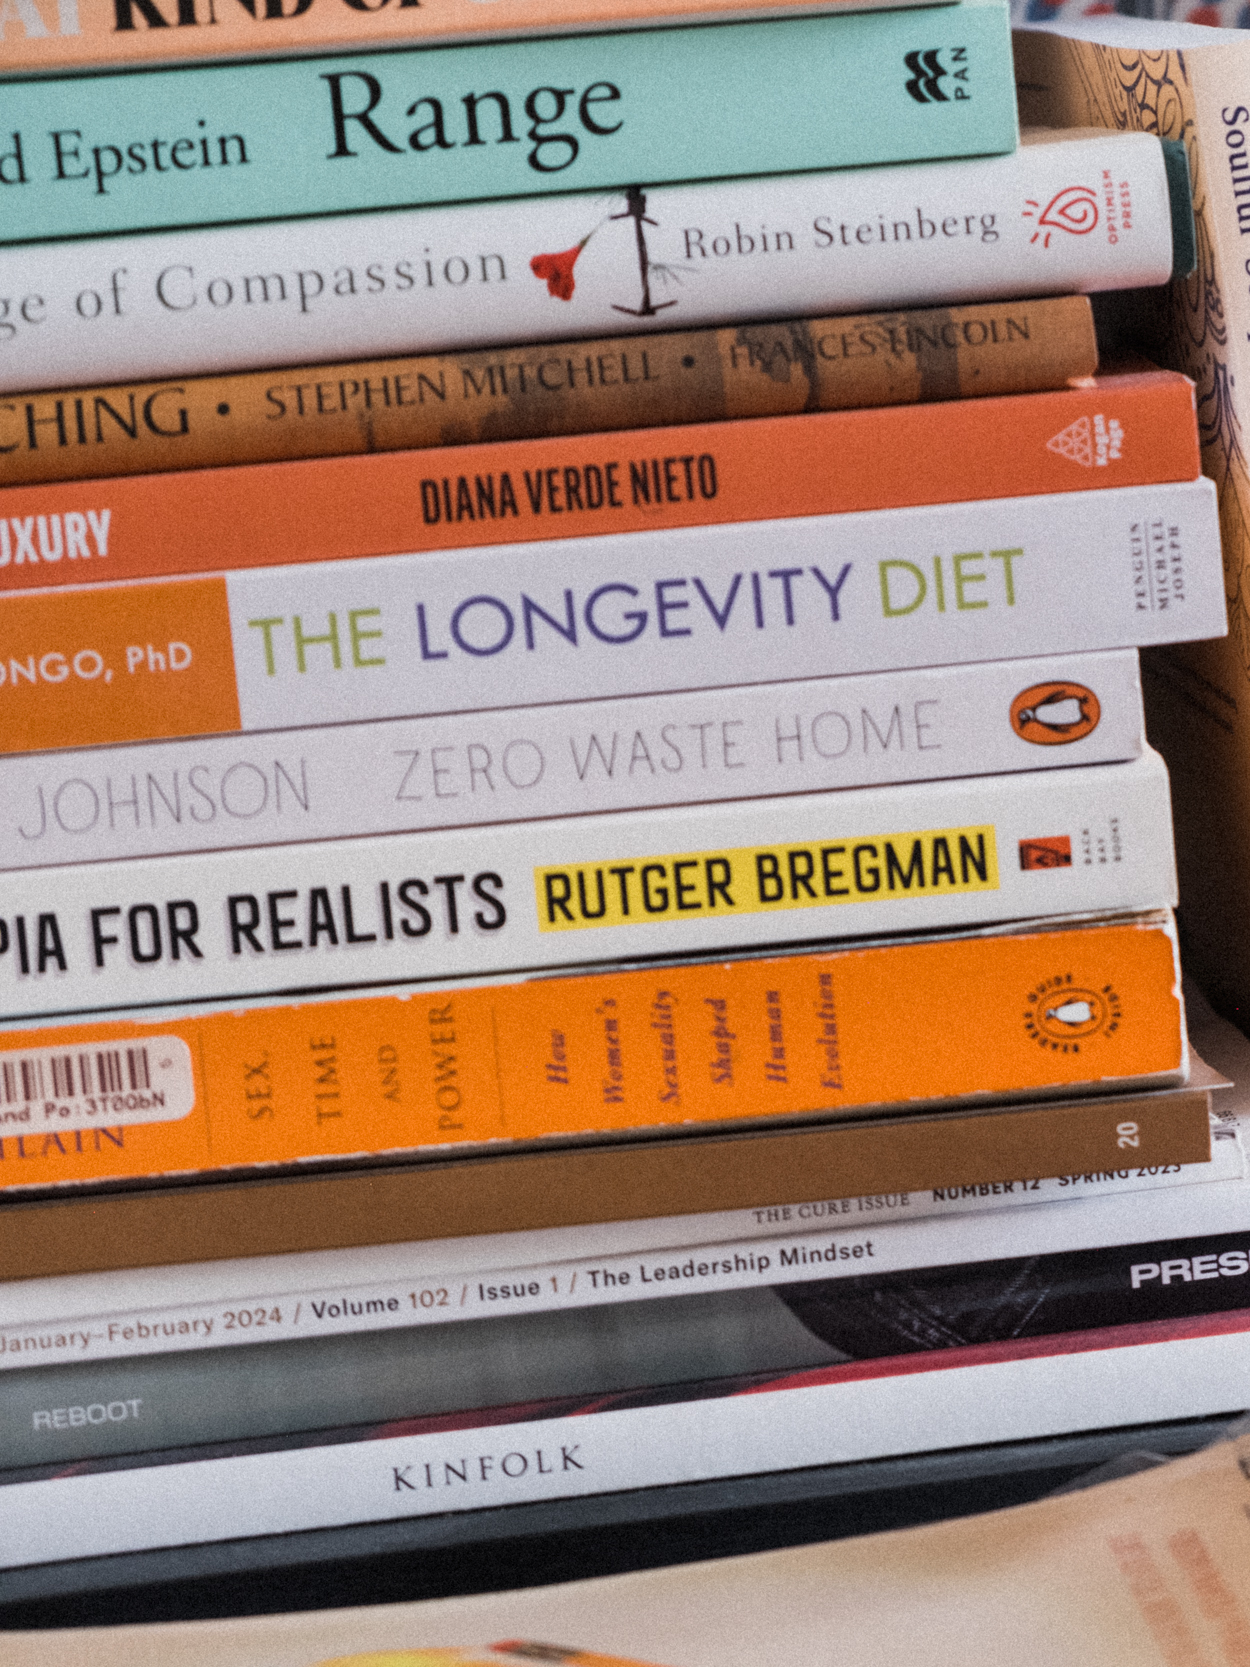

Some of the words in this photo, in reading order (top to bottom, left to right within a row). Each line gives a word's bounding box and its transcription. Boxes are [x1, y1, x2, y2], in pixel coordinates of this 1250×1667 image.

[953, 46, 968, 101] PAN
[48, 119, 250, 196] Epstein
[319, 70, 625, 173] Range
[682, 220, 796, 260] Robin
[813, 207, 1000, 248] Steinberg
[1102, 168, 1119, 245] OPTIMISM
[1120, 180, 1133, 230] PRESS
[75, 268, 128, 322] of
[155, 246, 508, 314] Compassion
[264, 369, 448, 421] STEPHEN
[462, 350, 660, 400] MITCHELL
[419, 470, 519, 525] DIANA
[523, 461, 622, 514] VERDE
[629, 453, 718, 506] NIETO
[1130, 521, 1147, 612] PENGUIN
[1153, 517, 1170, 612] MICHAEL
[1167, 524, 1185, 601] JOSEPH
[125, 641, 193, 674] PhD
[249, 607, 386, 676] THE
[416, 561, 853, 661] LONGEVITY
[877, 546, 1024, 619] DIET
[18, 757, 310, 841] JOHNSON
[394, 737, 545, 802] ZERO
[570, 720, 746, 781] WASTE
[775, 699, 943, 765] HOME
[89, 898, 205, 968] FOR
[228, 871, 508, 955] REALISTS
[544, 857, 735, 922] RUTGER
[755, 834, 989, 905] BREGMAN
[428, 1001, 464, 1131] POWER
[545, 1029, 569, 1085] How
[651, 989, 681, 1106] Sexuality
[704, 997, 737, 1087] Shaped
[765, 990, 789, 1084] Human
[812, 972, 844, 1091] Evolution
[309, 1035, 343, 1126] TIME
[377, 1044, 401, 1103] AND
[1116, 1120, 1140, 1149] 20
[752, 1206, 792, 1226] THE
[797, 1198, 852, 1220] CURE
[856, 1191, 911, 1214] ISSUE
[932, 1180, 1015, 1203] NUMBER
[1057, 1165, 1130, 1188] SPRING
[224, 1306, 283, 1330] 2024
[311, 1294, 400, 1321] Volume
[408, 1288, 450, 1310] 102
[479, 1277, 541, 1301] Issue
[587, 1266, 632, 1289] The
[640, 1252, 770, 1284] Leadership
[779, 1241, 875, 1266] Mindset
[32, 1399, 143, 1431] REBOOT
[391, 1444, 585, 1493] KINFOLK
